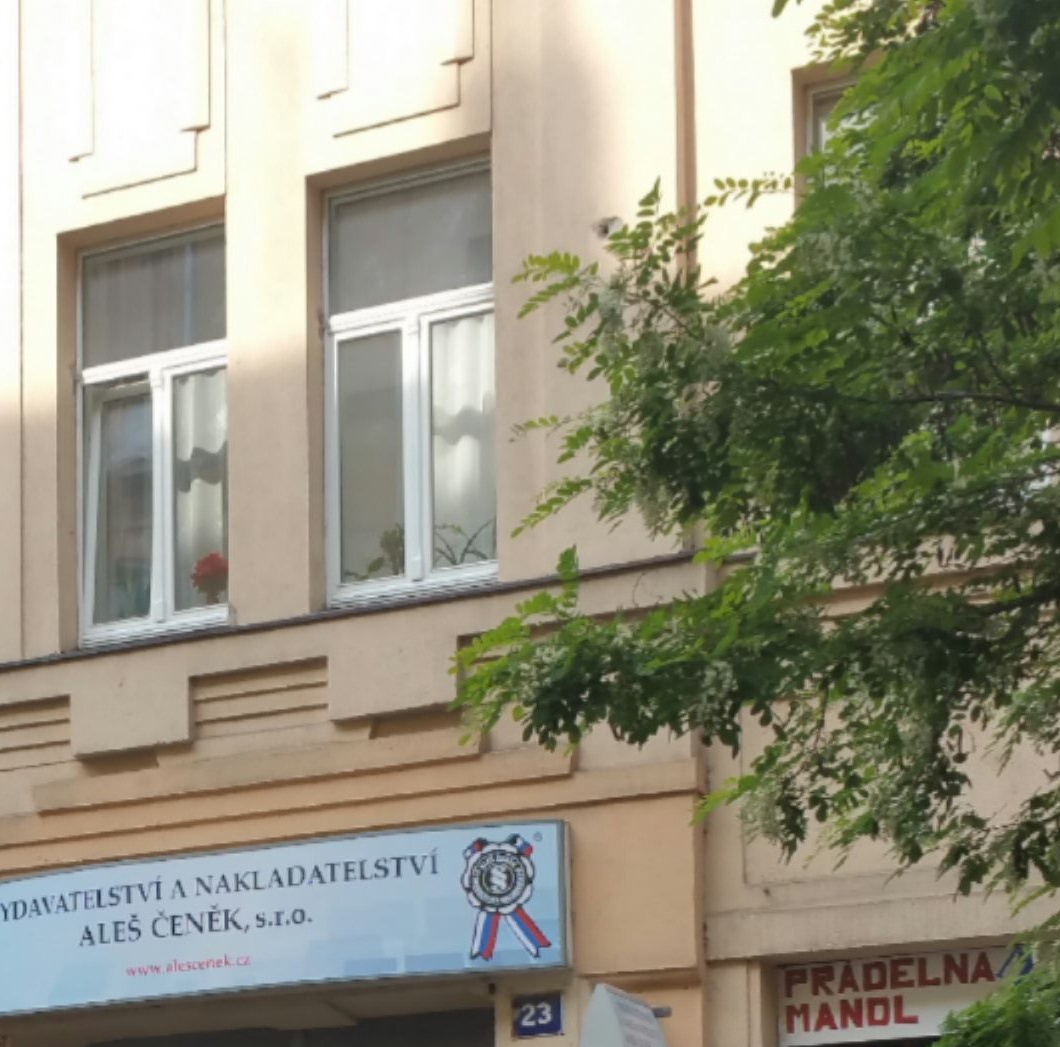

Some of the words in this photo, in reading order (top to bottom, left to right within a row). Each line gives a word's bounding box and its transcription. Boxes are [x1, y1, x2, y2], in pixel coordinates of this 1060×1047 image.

[170, 879, 187, 900] A
[195, 848, 439, 897] NAKLADATELSTVÍ
[79, 914, 142, 947] ALEŠ
[151, 904, 250, 938] ČENĚK,
[255, 908, 313, 928] s.r.o.
[126, 953, 252, 977] www.alescenek.cz
[520, 1003, 552, 1026] 23
